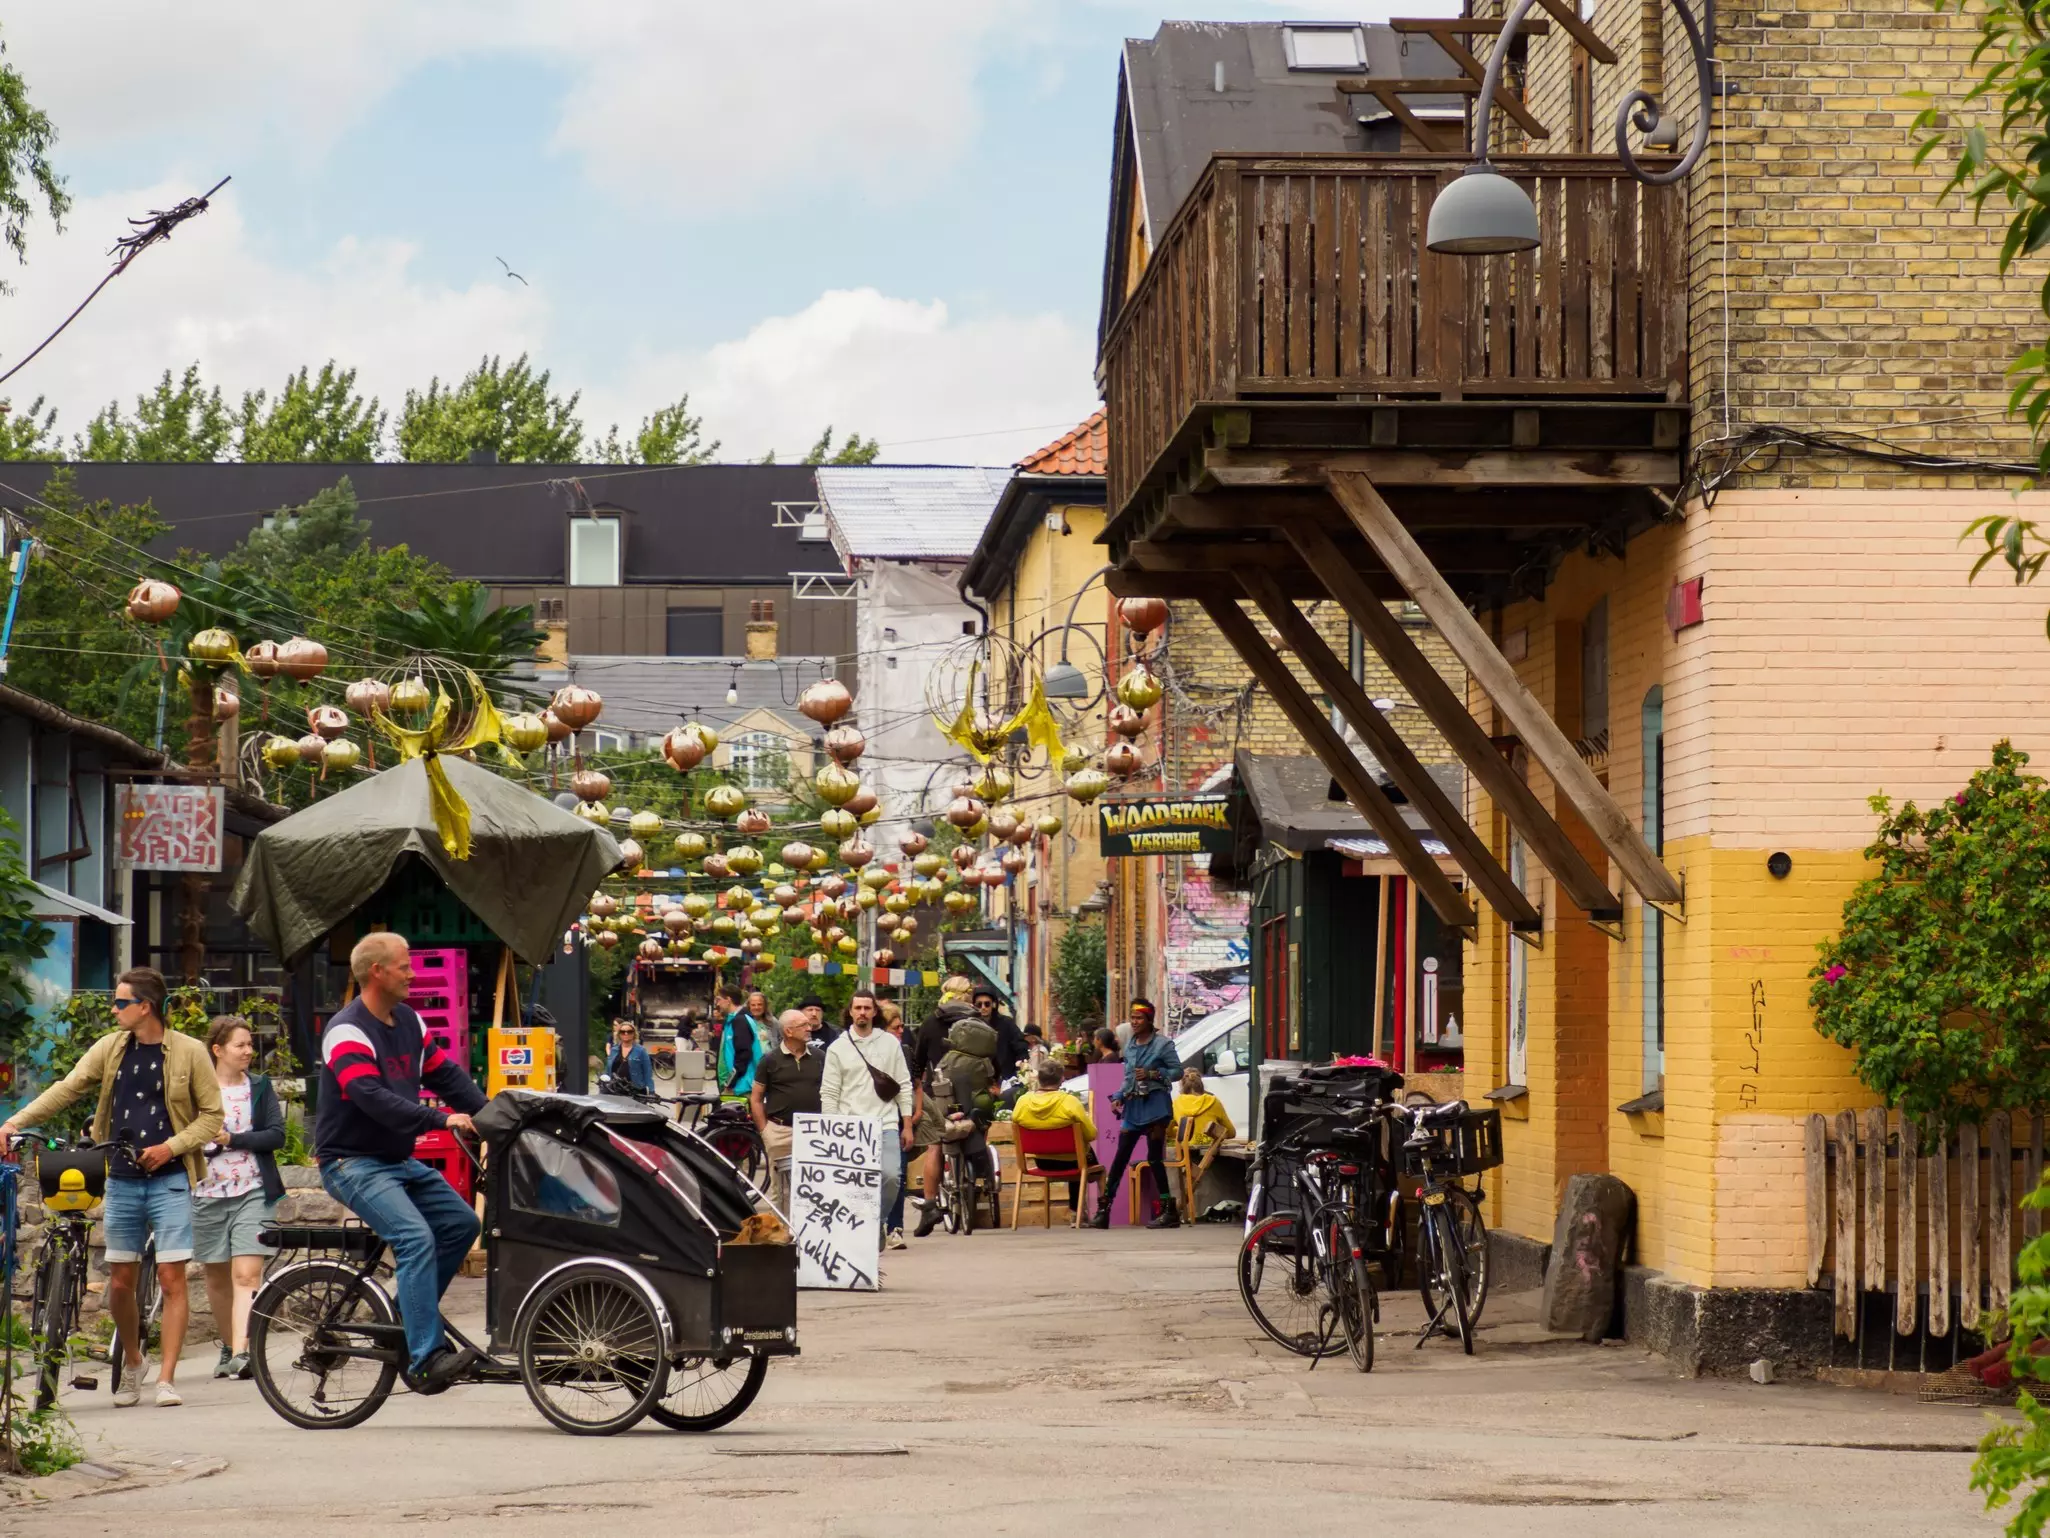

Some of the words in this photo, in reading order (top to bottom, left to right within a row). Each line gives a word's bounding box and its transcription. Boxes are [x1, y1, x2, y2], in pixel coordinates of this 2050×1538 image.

[1101, 802, 1232, 836] WOODSTOCK
[799, 1119, 872, 1146] INGEN
[810, 1139, 877, 1166] SALG!
[801, 1166, 825, 1183] NO
[833, 1169, 880, 1188] SALE
[806, 1208, 833, 1233] ER
